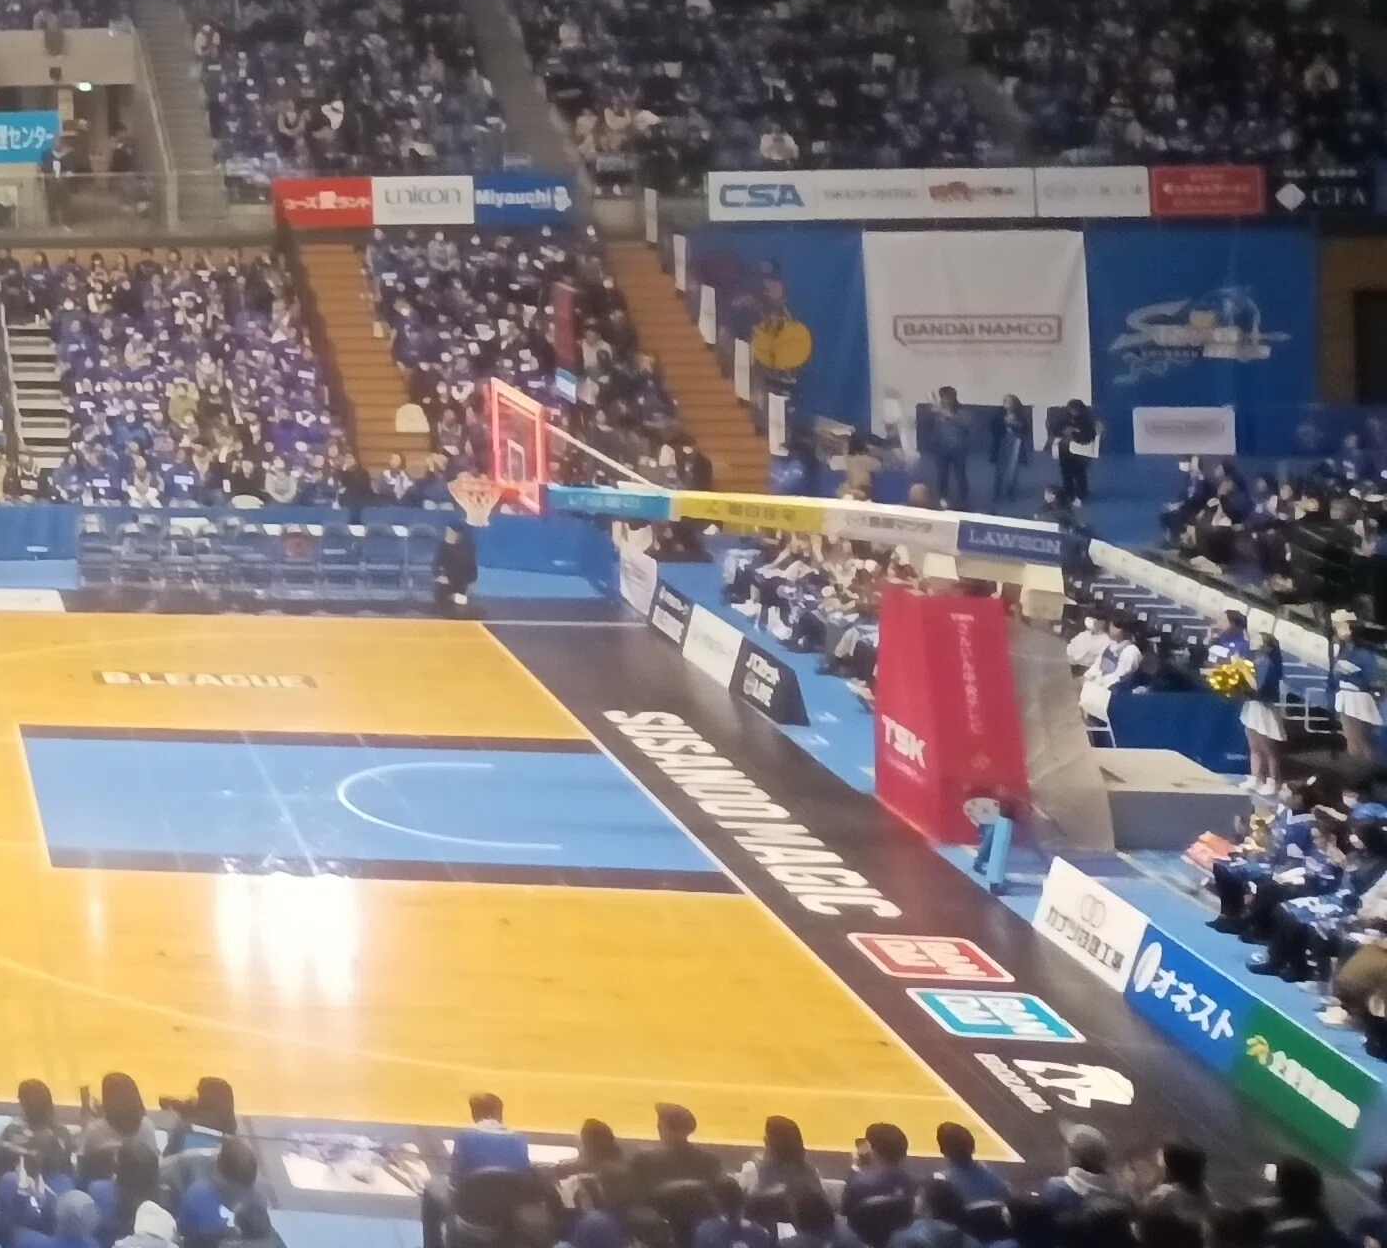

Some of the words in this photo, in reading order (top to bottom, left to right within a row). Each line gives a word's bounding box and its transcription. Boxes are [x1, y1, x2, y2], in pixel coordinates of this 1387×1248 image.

[384, 184, 462, 205] unicon
[719, 183, 805, 208] CSA
[902, 322, 975, 336] BANDAI
[977, 322, 1053, 336] NAMCO
[966, 528, 1062, 555] LAWSON
[881, 713, 927, 770] TSK
[602, 709, 791, 819] SUSANOO
[715, 820, 904, 919] MAGIC
[1151, 968, 1235, 1041] オネスト
